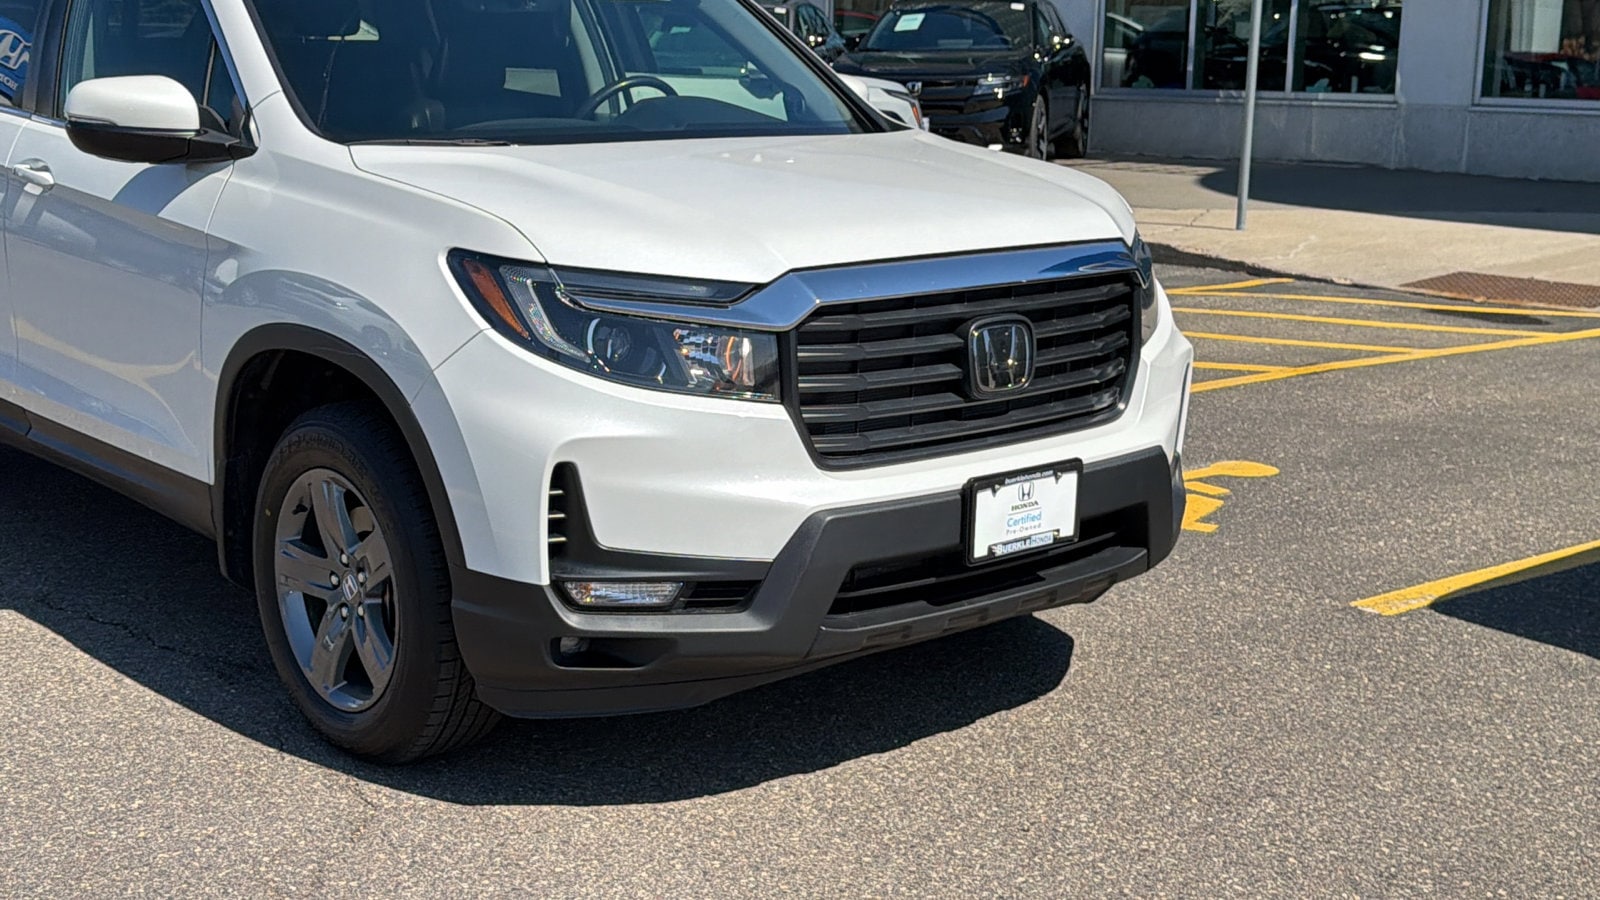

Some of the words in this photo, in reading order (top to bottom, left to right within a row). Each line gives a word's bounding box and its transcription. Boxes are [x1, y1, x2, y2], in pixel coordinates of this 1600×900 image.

[1011, 501, 1039, 511] HONDA
[1007, 512, 1042, 528] Certified
[1006, 523, 1042, 535] Pre-Owned
